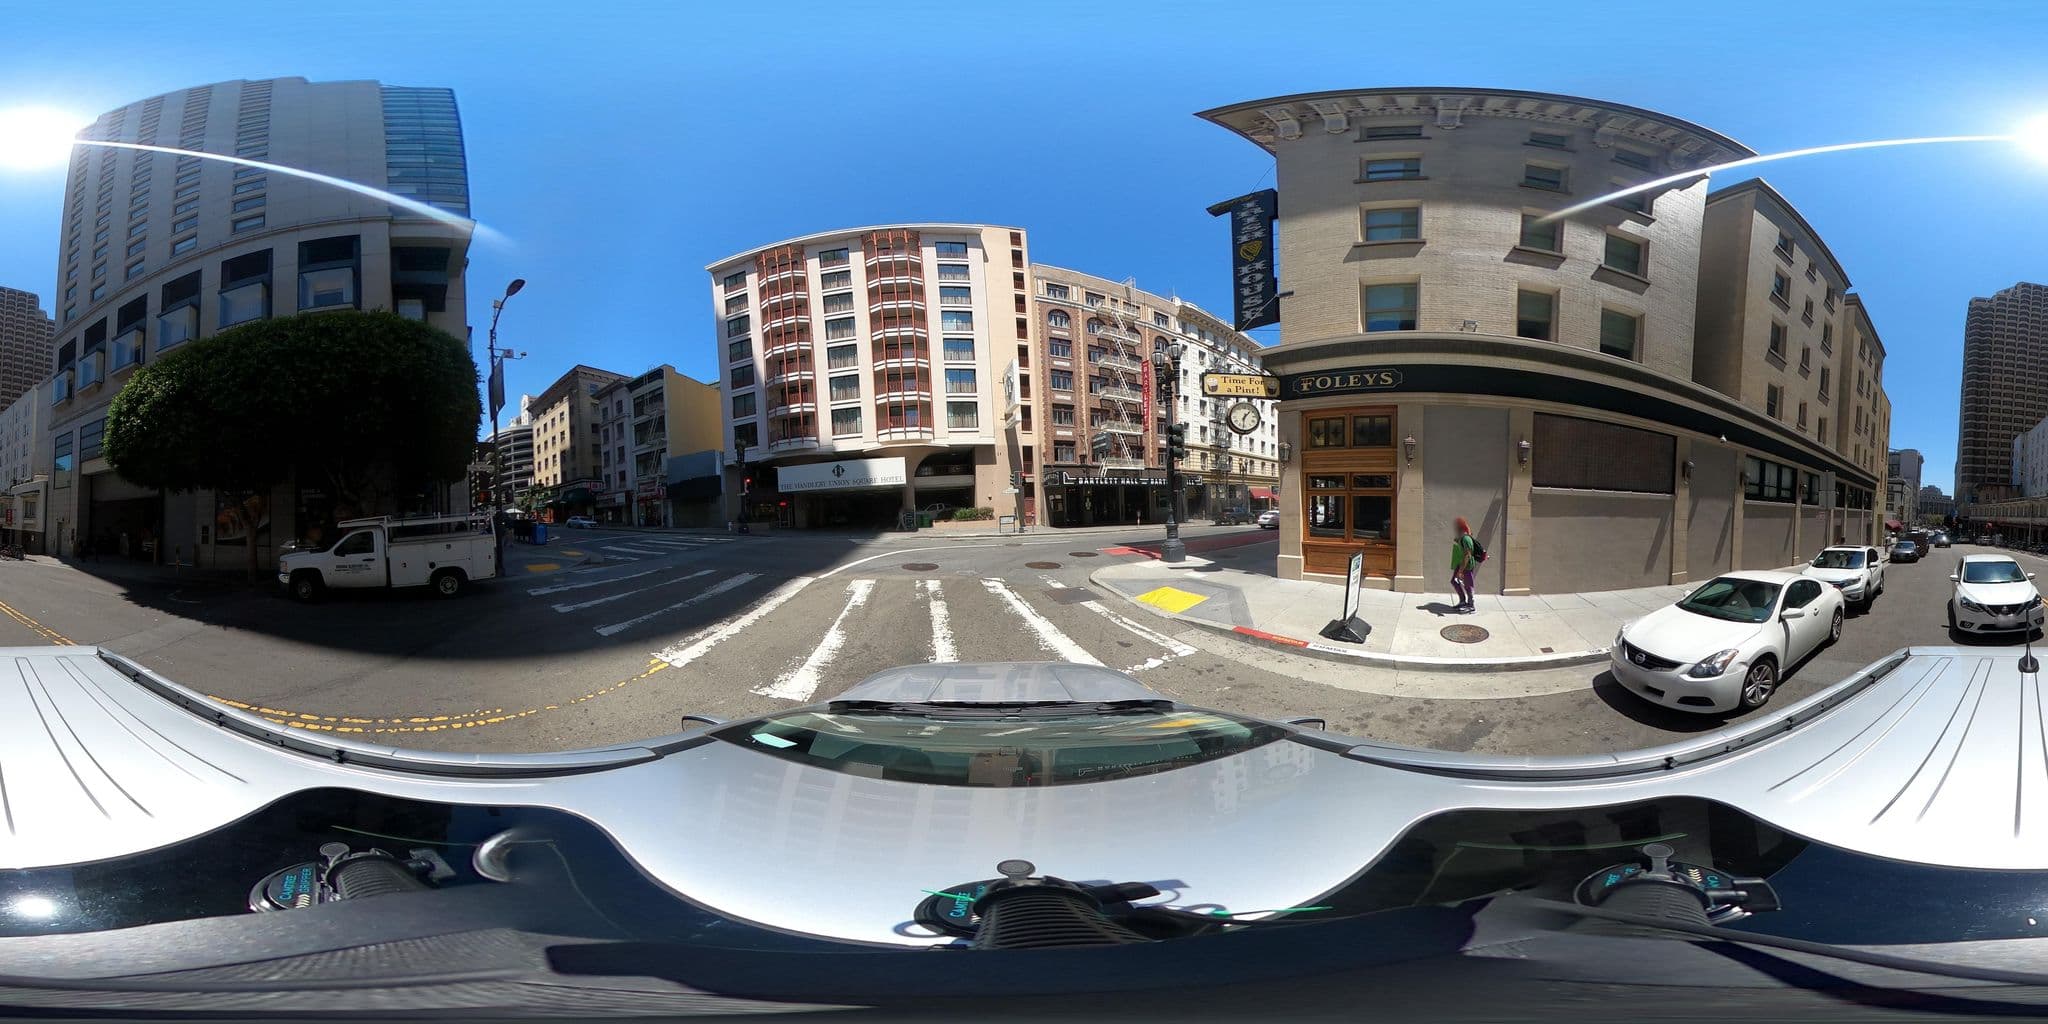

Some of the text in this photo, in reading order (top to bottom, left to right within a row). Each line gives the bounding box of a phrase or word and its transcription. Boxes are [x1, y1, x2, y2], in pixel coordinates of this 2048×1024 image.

[1238, 260, 1266, 321] HOUSE
[1221, 376, 1246, 385] Time
[1301, 372, 1393, 391] FOLEYS
[1235, 385, 1259, 394] Pint!
[828, 479, 850, 488] UNION
[853, 477, 878, 486] SQUARE
[881, 475, 904, 484] HOTEL
[1078, 477, 1118, 485] BARTLETT
[1121, 477, 1139, 485] HALL
